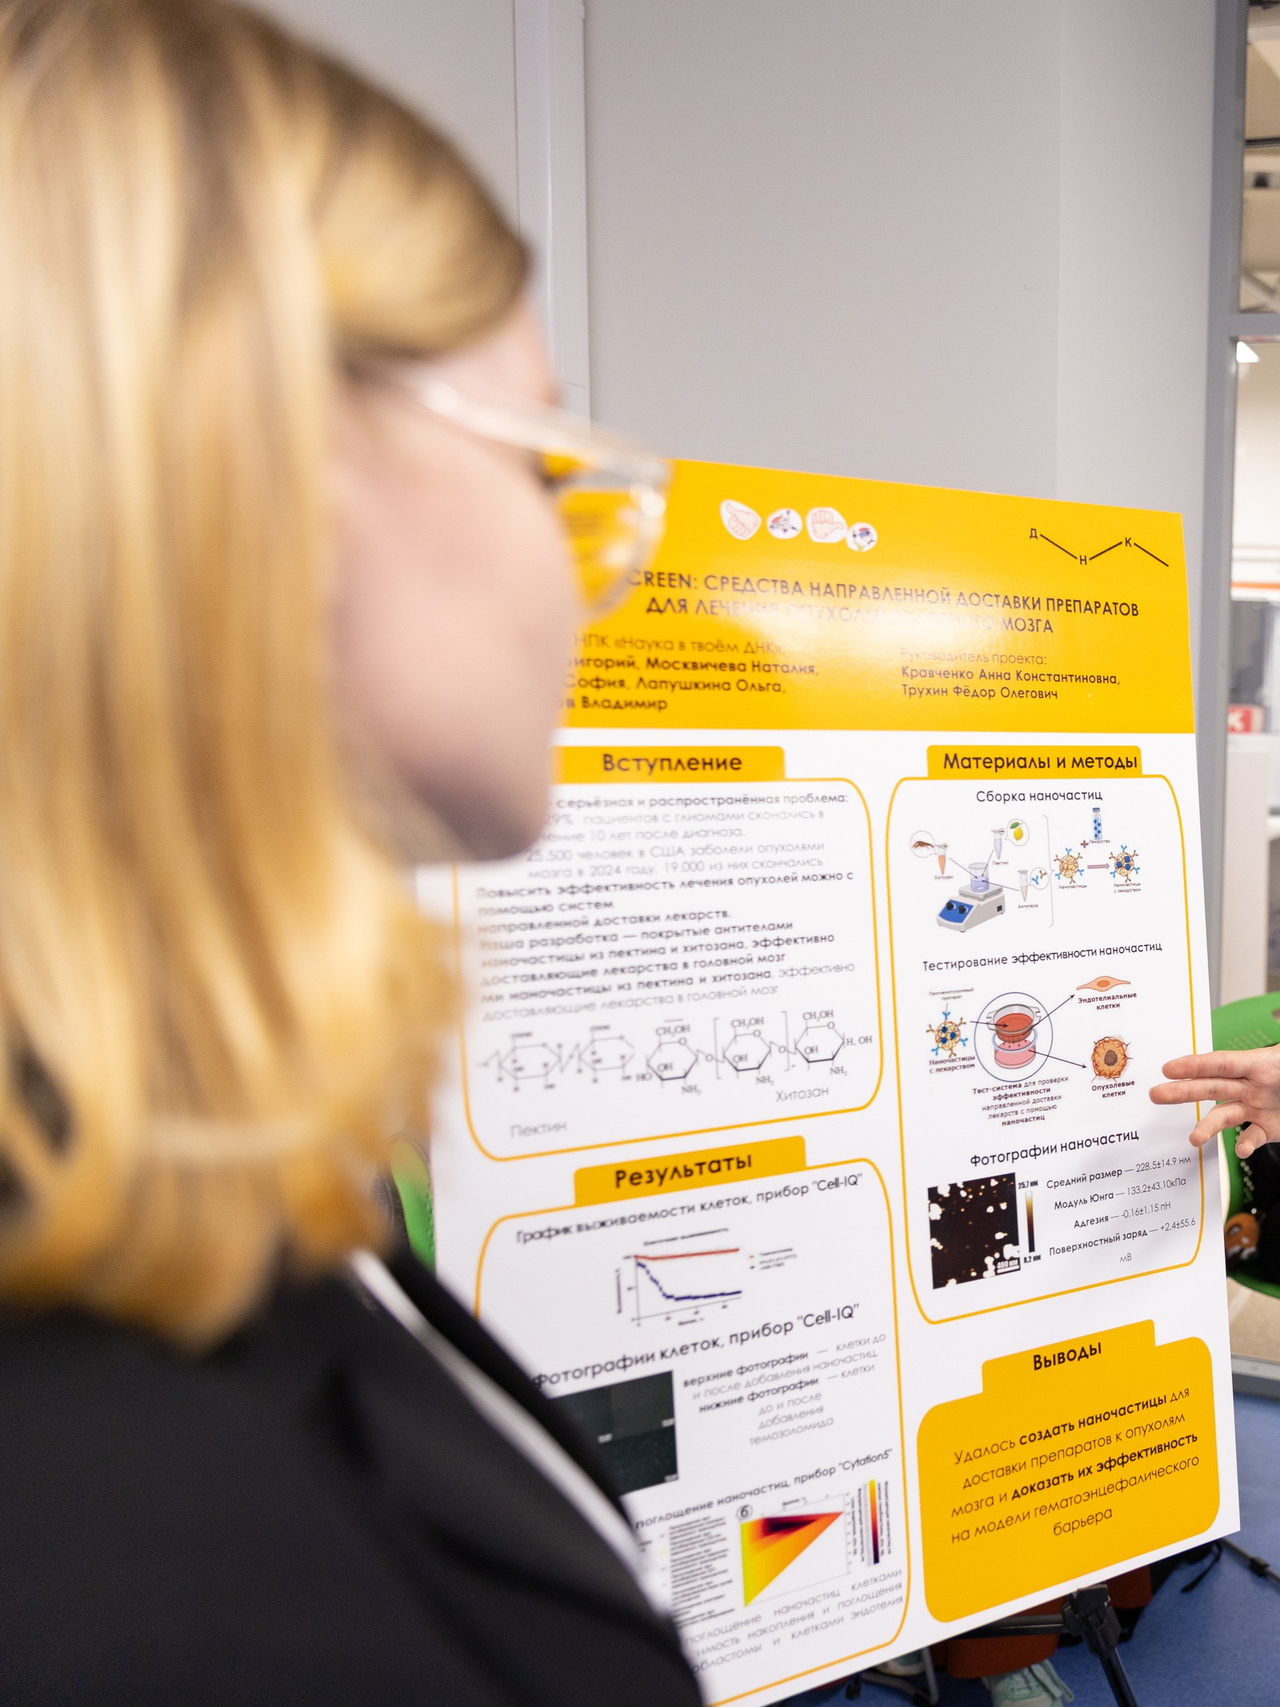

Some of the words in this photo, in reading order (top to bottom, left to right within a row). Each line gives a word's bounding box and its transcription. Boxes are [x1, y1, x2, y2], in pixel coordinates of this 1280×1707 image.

[1029, 528, 1038, 539] Д
[1079, 555, 1088, 566] Н
[1125, 537, 1132, 548] К
[704, 574, 802, 597] СРЕДСТВА
[811, 581, 950, 605] НАПРАВЛЕННОЙ
[957, 590, 1041, 611] ДОСТАВКИ
[1046, 595, 1139, 617] ПРЕПАРАТОВ
[646, 595, 688, 616] ДЛЯ
[1000, 614, 1054, 633] МОЗГА
[646, 655, 747, 673] Москвичева
[752, 659, 819, 678] Наталия,
[992, 651, 1047, 668] проекта:
[636, 676, 731, 694] Лапушкина
[737, 678, 786, 695] Ольга,
[902, 663, 974, 682] Кравченко
[978, 666, 1011, 681] Анна
[1015, 667, 1121, 686] Константиновна,
[902, 682, 948, 700] Трухин
[952, 683, 996, 701] Фёдор
[1000, 684, 1058, 699] Олегович
[582, 695, 668, 714] Владимир
[603, 753, 742, 775] Вступление
[943, 753, 1051, 773] Материалы
[1057, 756, 1066, 769] и
[1071, 754, 1138, 770] методы
[556, 795, 633, 812] серьёзная
[649, 792, 780, 810] распространённая
[783, 790, 848, 808] проблема:
[976, 790, 1026, 804] Сборка
[1029, 790, 1103, 802] наночастиц
[557, 880, 675, 898] эффективность
[680, 877, 734, 890] лечения
[738, 871, 798, 890] опухолей
[802, 871, 843, 883] можно
[478, 902, 554, 916] помощью
[559, 899, 614, 911] систем
[478, 914, 589, 936] направленной
[594, 912, 661, 928] доставки
[665, 908, 732, 924] лекарств.
[529, 932, 619, 951] разработка
[641, 925, 710, 942] покрытые
[715, 920, 793, 935] антителами
[481, 951, 585, 968] наночастицы
[590, 950, 604, 961] из
[609, 945, 667, 959] пектина
[683, 939, 748, 954] хитозана,
[752, 933, 835, 952] эффективно
[923, 955, 1008, 972] Тестирование
[1012, 948, 1097, 965] эффективности
[1099, 942, 1162, 956] наночастиц
[481, 967, 598, 988] доставляющие
[603, 960, 678, 977] лекарства
[694, 951, 753, 969] головной
[757, 952, 785, 963] мозг
[509, 982, 612, 1000] наночастицы
[617, 980, 632, 991] из
[637, 975, 694, 990] пектина
[712, 969, 774, 984] хитозана,
[1078, 992, 1137, 1004] Эндотелиальные
[1096, 1002, 1121, 1011] клетки
[929, 1056, 975, 1065] Наночастицы
[935, 1064, 975, 1073] лекарством
[776, 1087, 829, 1103] Хитозан
[972, 1082, 1022, 1095] Тест-система
[1024, 1080, 1036, 1088] для
[1037, 1076, 1069, 1088] проверки
[992, 1087, 1051, 1101] эффективности
[1091, 1080, 1135, 1093] Опухолевые
[1101, 1090, 1126, 1099] клетки
[982, 1099, 1031, 1112] направленной
[1032, 1094, 1062, 1106] доставки
[988, 1108, 1019, 1120] лекарств
[1026, 1104, 1057, 1115] помощью
[511, 1121, 567, 1138] Пектин
[1001, 1114, 1046, 1127] наночастиц
[970, 1143, 1058, 1167] Фотографии
[1060, 1129, 1140, 1153] наночастиц
[614, 1154, 752, 1189] Результаты
[1046, 1173, 1088, 1189] Средний
[1089, 1168, 1123, 1184] размер
[1135, 1157, 1177, 1173] 228.5±14.9
[1179, 1155, 1191, 1165] нм
[1054, 1197, 1088, 1211] Модуль
[1090, 1191, 1114, 1203] Юнга
[517, 1224, 574, 1245] График
[700, 1194, 752, 1211] клеток,
[757, 1184, 809, 1203] прибор
[1074, 1214, 1109, 1229] Адгезия
[1049, 1232, 1120, 1258] Поверхностный
[1122, 1227, 1148, 1243] заряд
[535, 1350, 656, 1388] Фотографии
[660, 1336, 725, 1359] клеток,
[729, 1318, 794, 1345] прибор
[797, 1303, 859, 1328] "Cell-IQ"
[1032, 1342, 1102, 1372] Выводы
[683, 1367, 733, 1388] верхние
[736, 1351, 809, 1376] фотографии
[699, 1395, 744, 1413] нижние
[747, 1377, 819, 1404] фотографии
[953, 1438, 1016, 1465] Удалось
[1019, 1421, 1075, 1446] создать
[1078, 1393, 1168, 1430] наночастицы
[1170, 1387, 1190, 1402] для
[962, 1460, 1027, 1489] доставки
[1030, 1434, 1112, 1469] препаратов
[1116, 1432, 1122, 1443] к
[1125, 1413, 1186, 1440] опухолям
[794, 1466, 836, 1486] прибор
[951, 1495, 995, 1518] мозга
[999, 1491, 1008, 1502] и
[1011, 1471, 1075, 1501] доказать
[1078, 1464, 1093, 1478] их
[1096, 1433, 1198, 1474] эффективность
[951, 1529, 970, 1544] на
[974, 1511, 1031, 1538] модели
[1034, 1456, 1200, 1518] гематоэнцефалического
[1053, 1507, 1113, 1536] барьера
